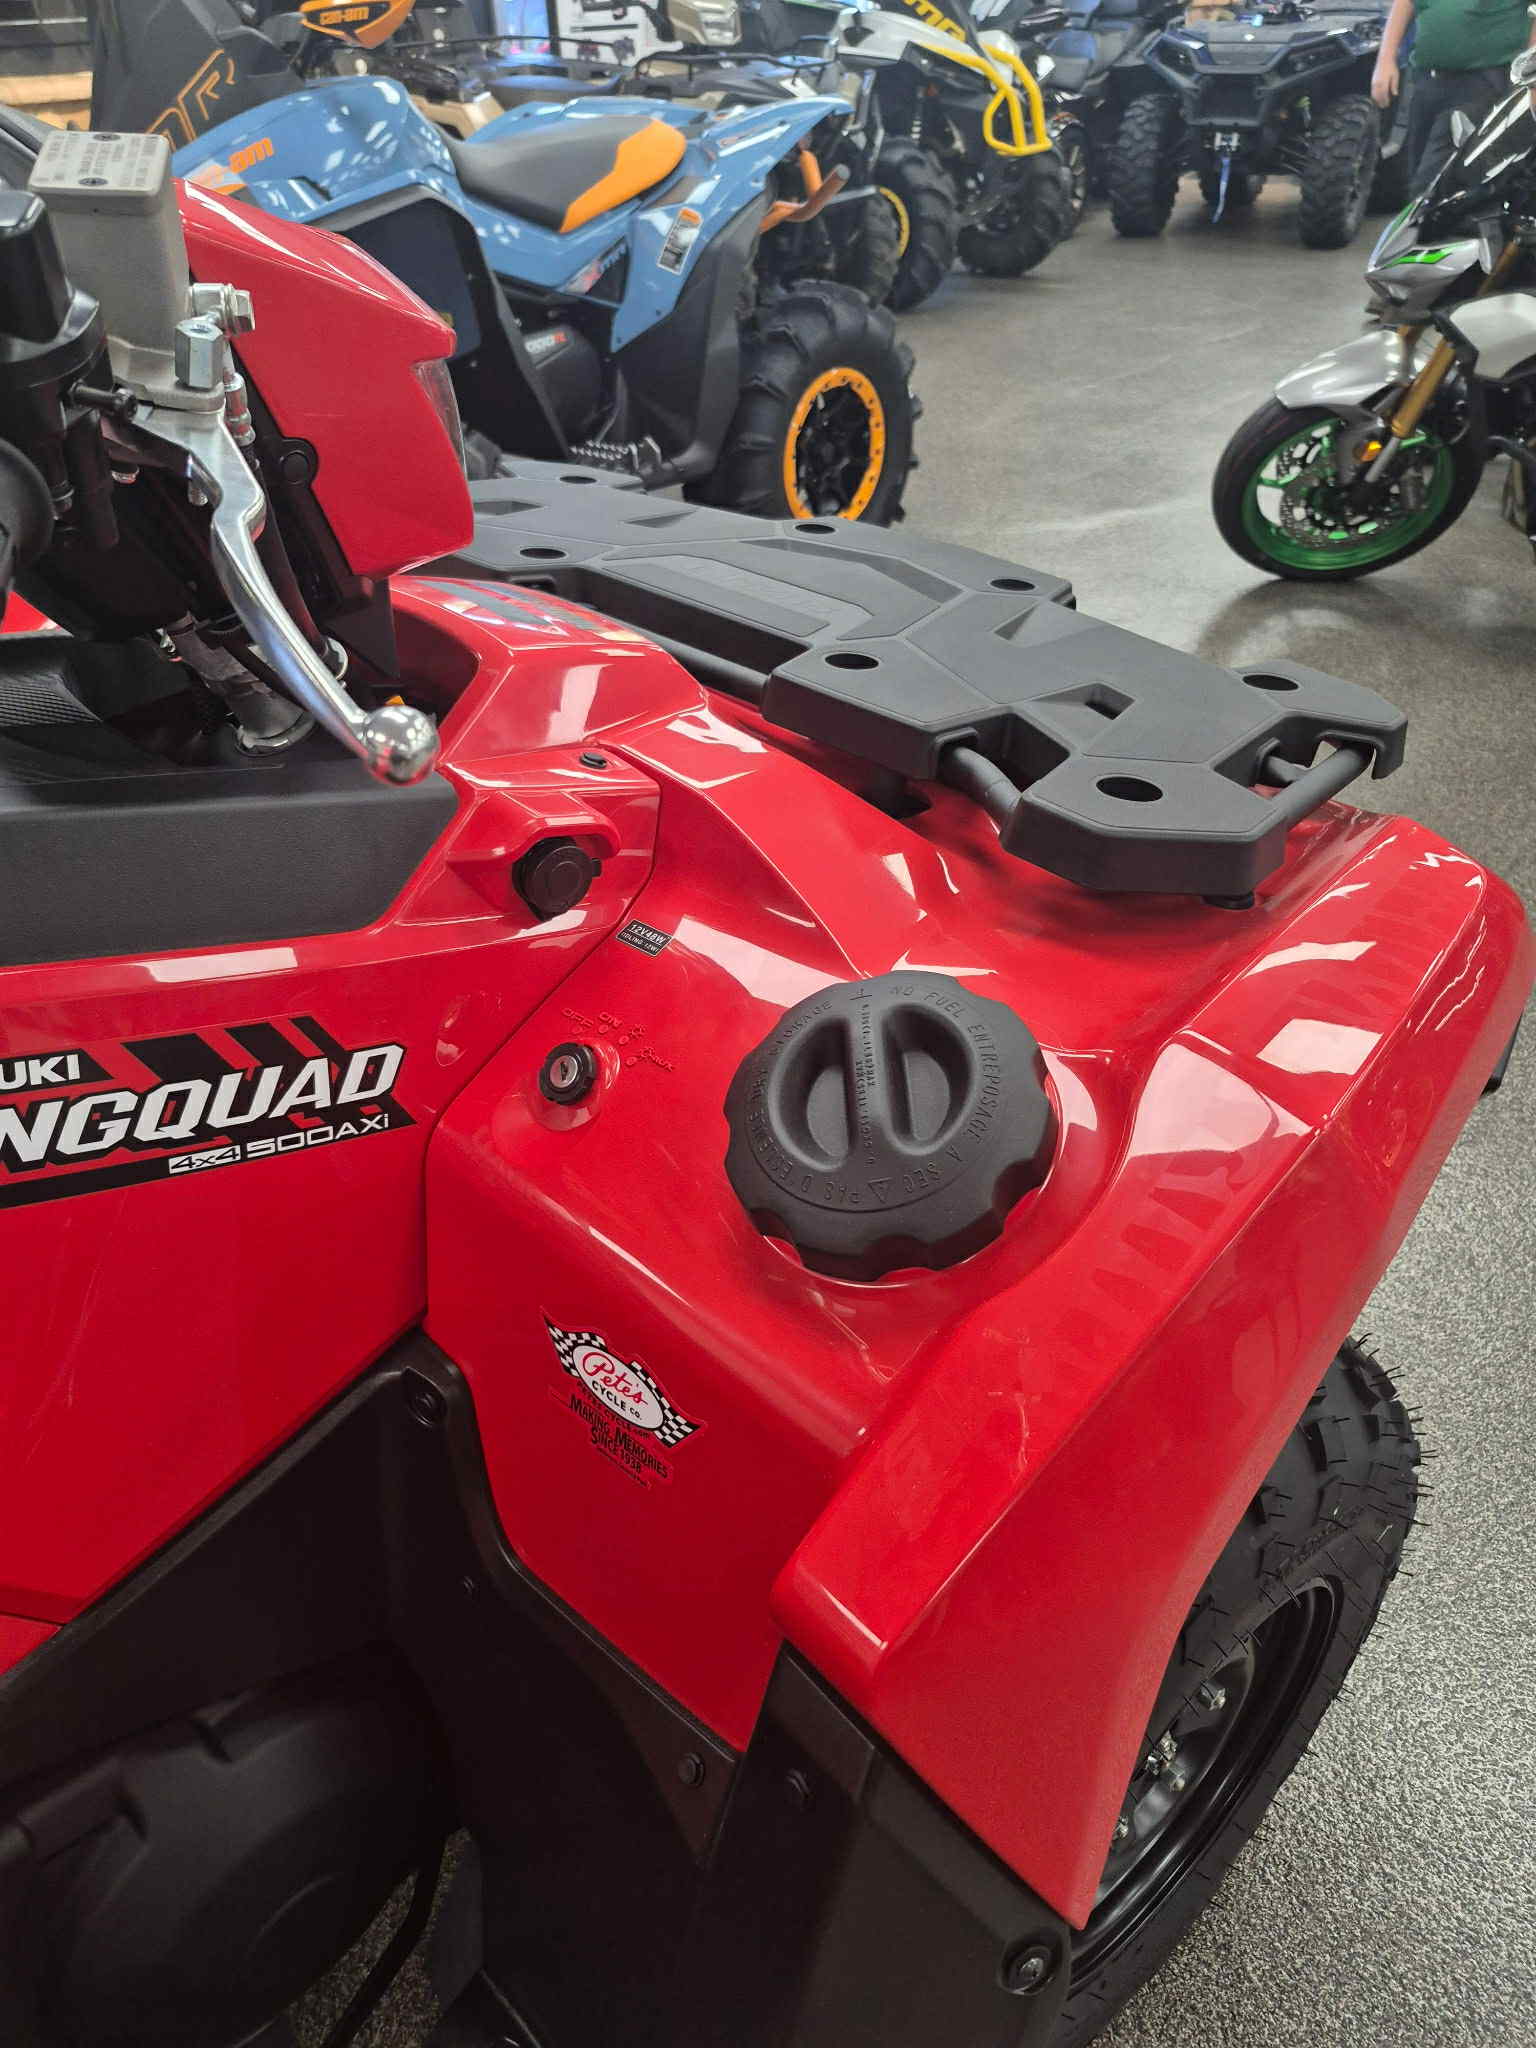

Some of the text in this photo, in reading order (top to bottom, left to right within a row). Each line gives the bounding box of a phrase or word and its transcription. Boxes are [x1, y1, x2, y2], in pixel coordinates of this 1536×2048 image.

[923, 991, 968, 1019] FUEL
[0, 1044, 404, 1163] NGQUAD
[246, 1113, 389, 1158] 500AXi
[582, 1351, 648, 1405] Pete's
[592, 1381, 626, 1410] CYCLE
